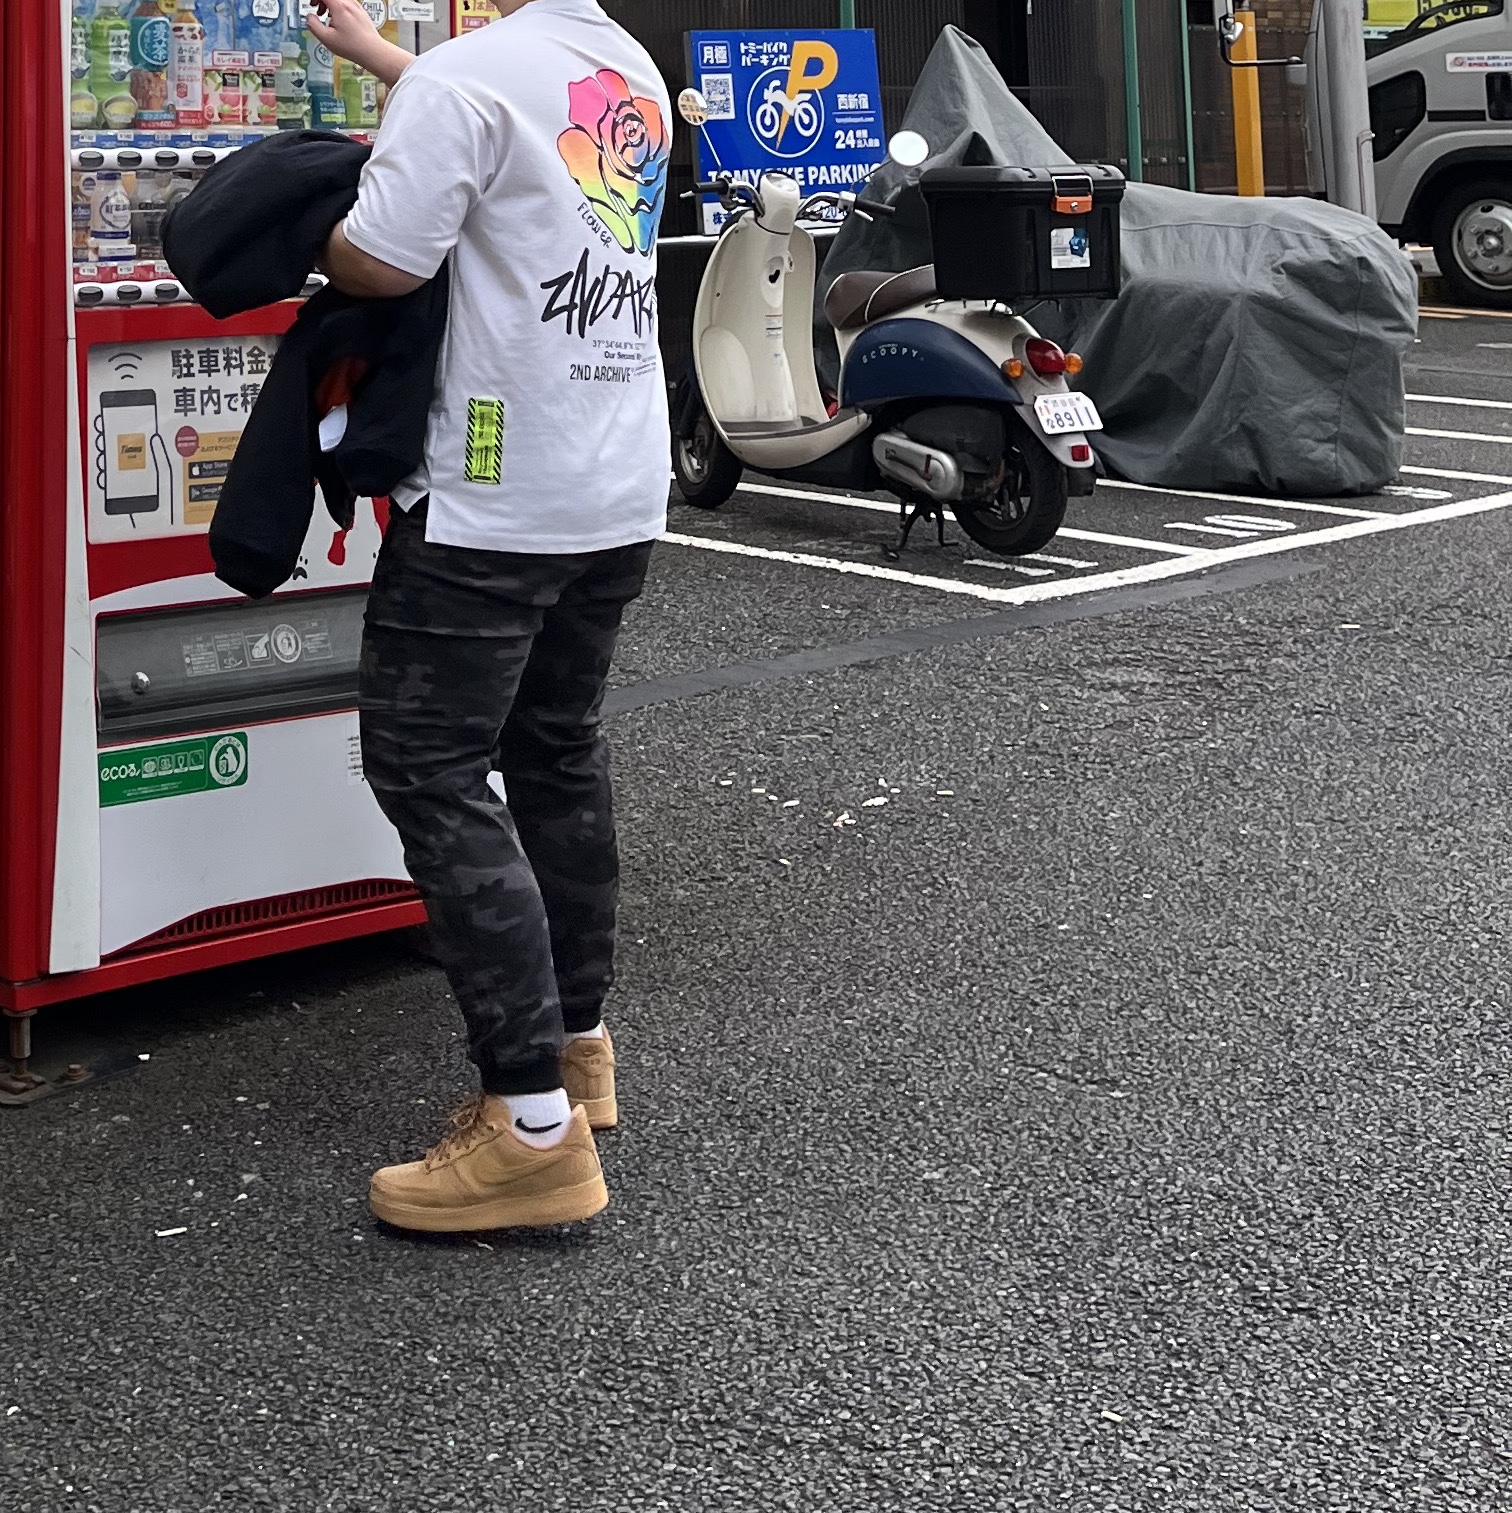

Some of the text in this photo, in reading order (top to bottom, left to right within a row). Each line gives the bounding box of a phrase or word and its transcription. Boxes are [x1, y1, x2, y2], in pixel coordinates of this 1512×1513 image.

[363, 2, 384, 13] CHILL
[703, 45, 728, 65] 月極
[739, 41, 787, 54] トミーバイク
[741, 54, 791, 67] パーキング
[784, 40, 839, 101] P
[836, 93, 869, 110] 西新宿
[834, 129, 856, 150] 24
[707, 168, 763, 186] TOMY
[170, 345, 274, 379] 駐車料金
[861, 345, 919, 365] SCOOPY
[570, 364, 631, 383] 2ND ARCHIVE
[1054, 406, 1095, 428] 8911
